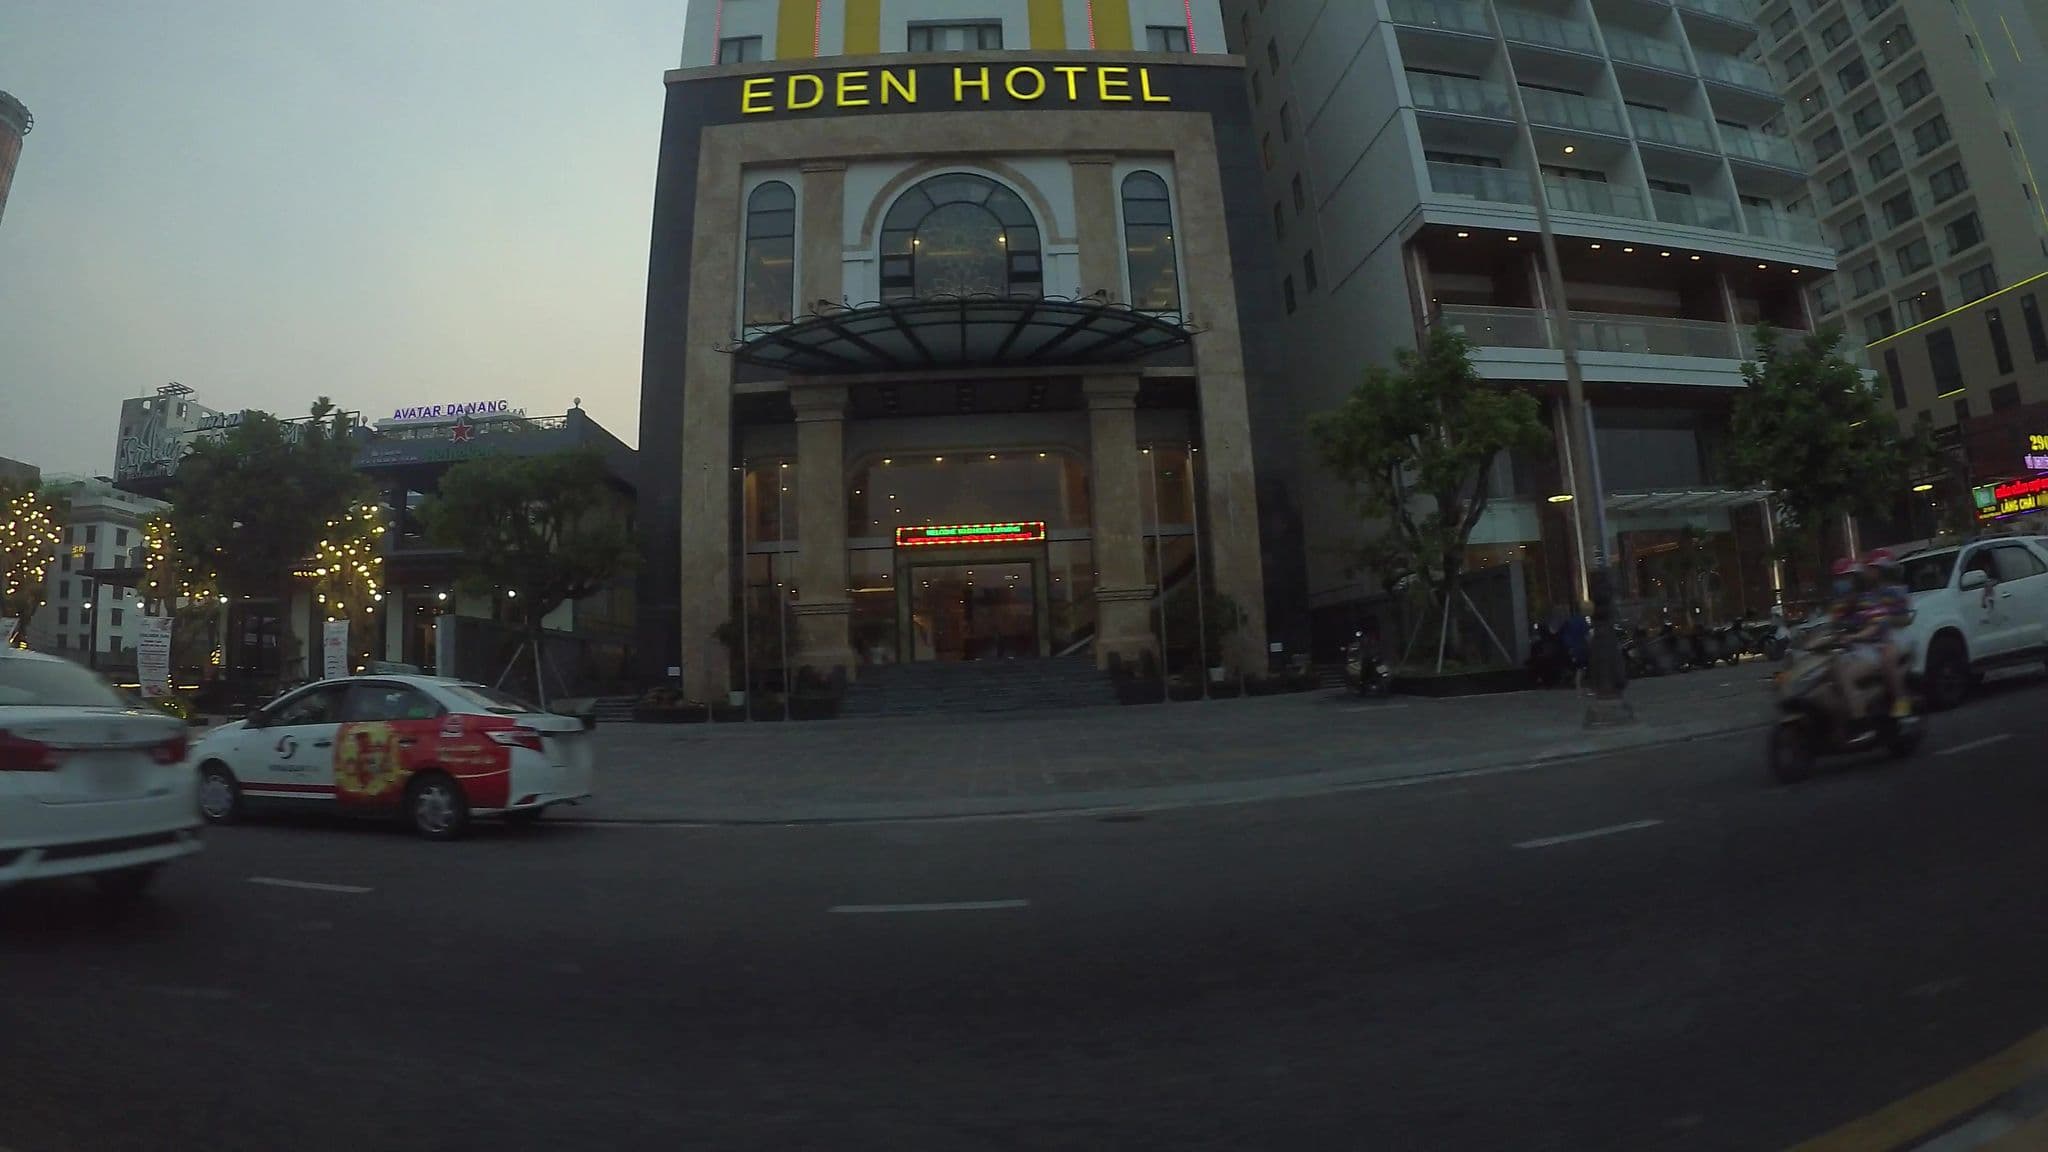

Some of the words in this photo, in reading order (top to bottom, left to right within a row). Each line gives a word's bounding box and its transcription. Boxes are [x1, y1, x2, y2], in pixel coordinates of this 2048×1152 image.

[740, 68, 918, 115] EDEN
[953, 65, 1172, 105] HOTEL
[393, 405, 441, 419] AVATAR
[447, 404, 464, 415] DA
[467, 400, 507, 414] NANG
